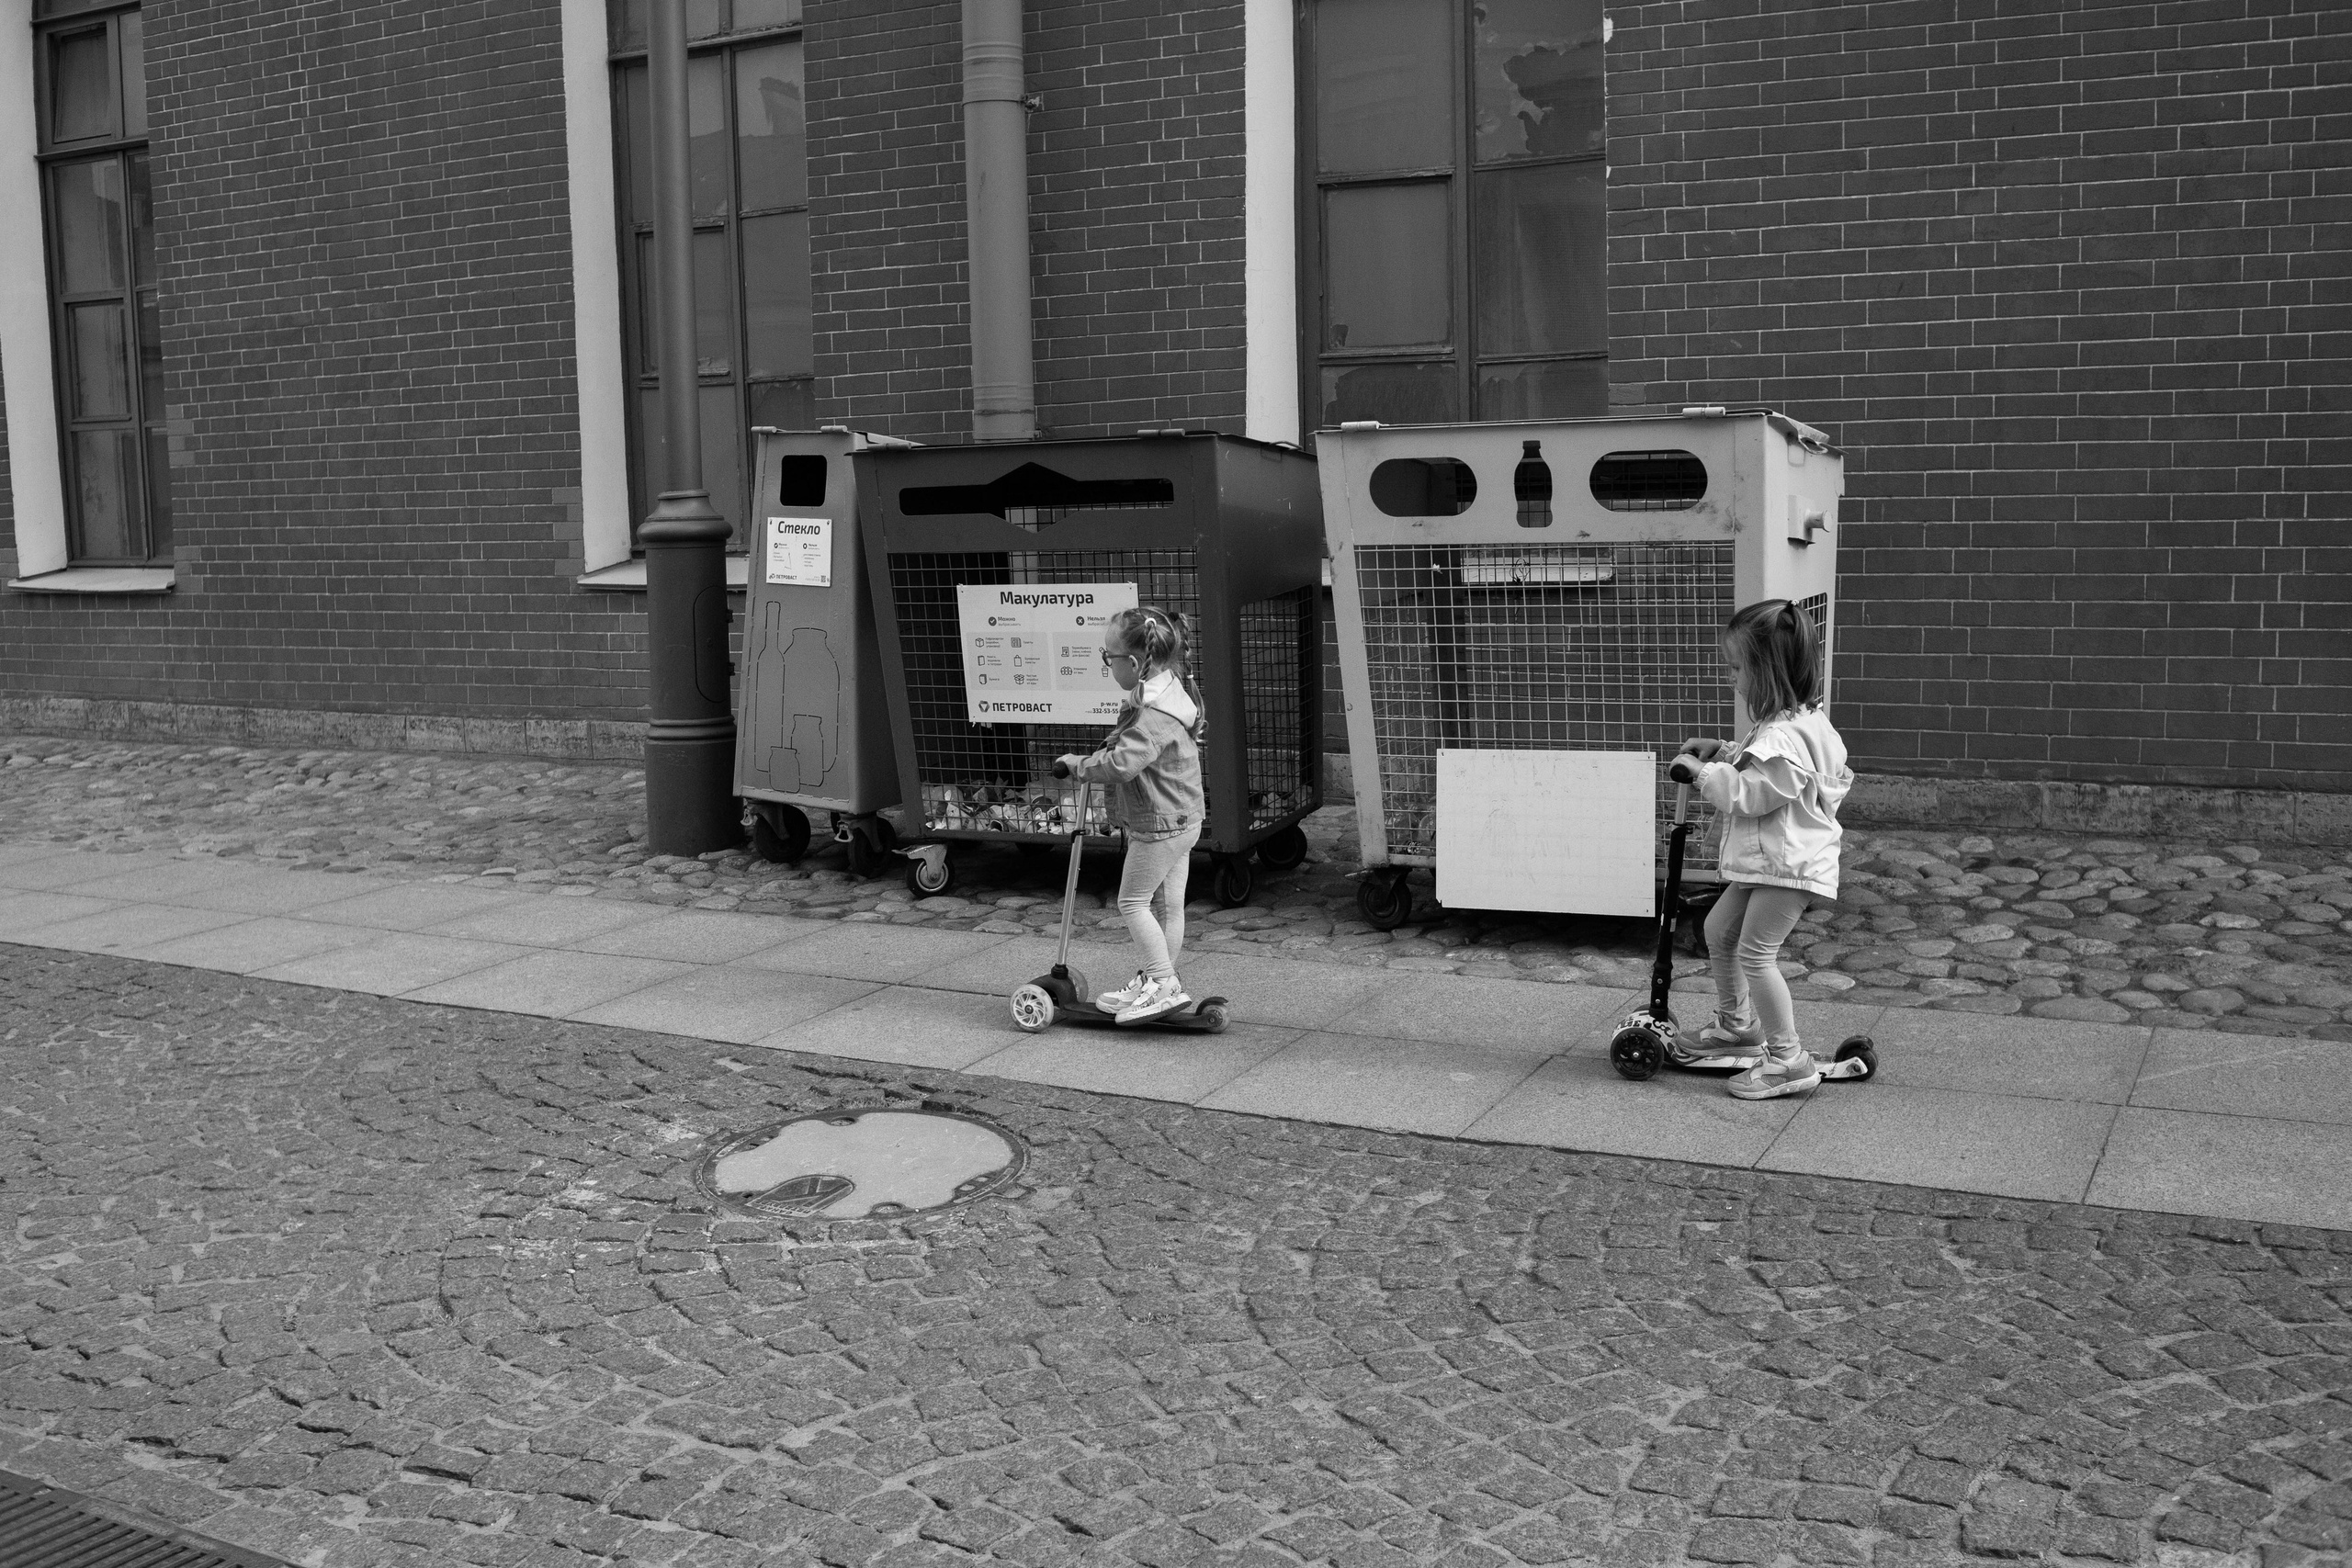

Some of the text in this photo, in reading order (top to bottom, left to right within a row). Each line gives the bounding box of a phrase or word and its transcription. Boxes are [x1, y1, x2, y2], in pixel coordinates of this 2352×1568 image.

[777, 521, 820, 536] Стекло
[1000, 591, 1094, 608] Макулатура
[992, 703, 1053, 713] ПЕТРОВАСТ
